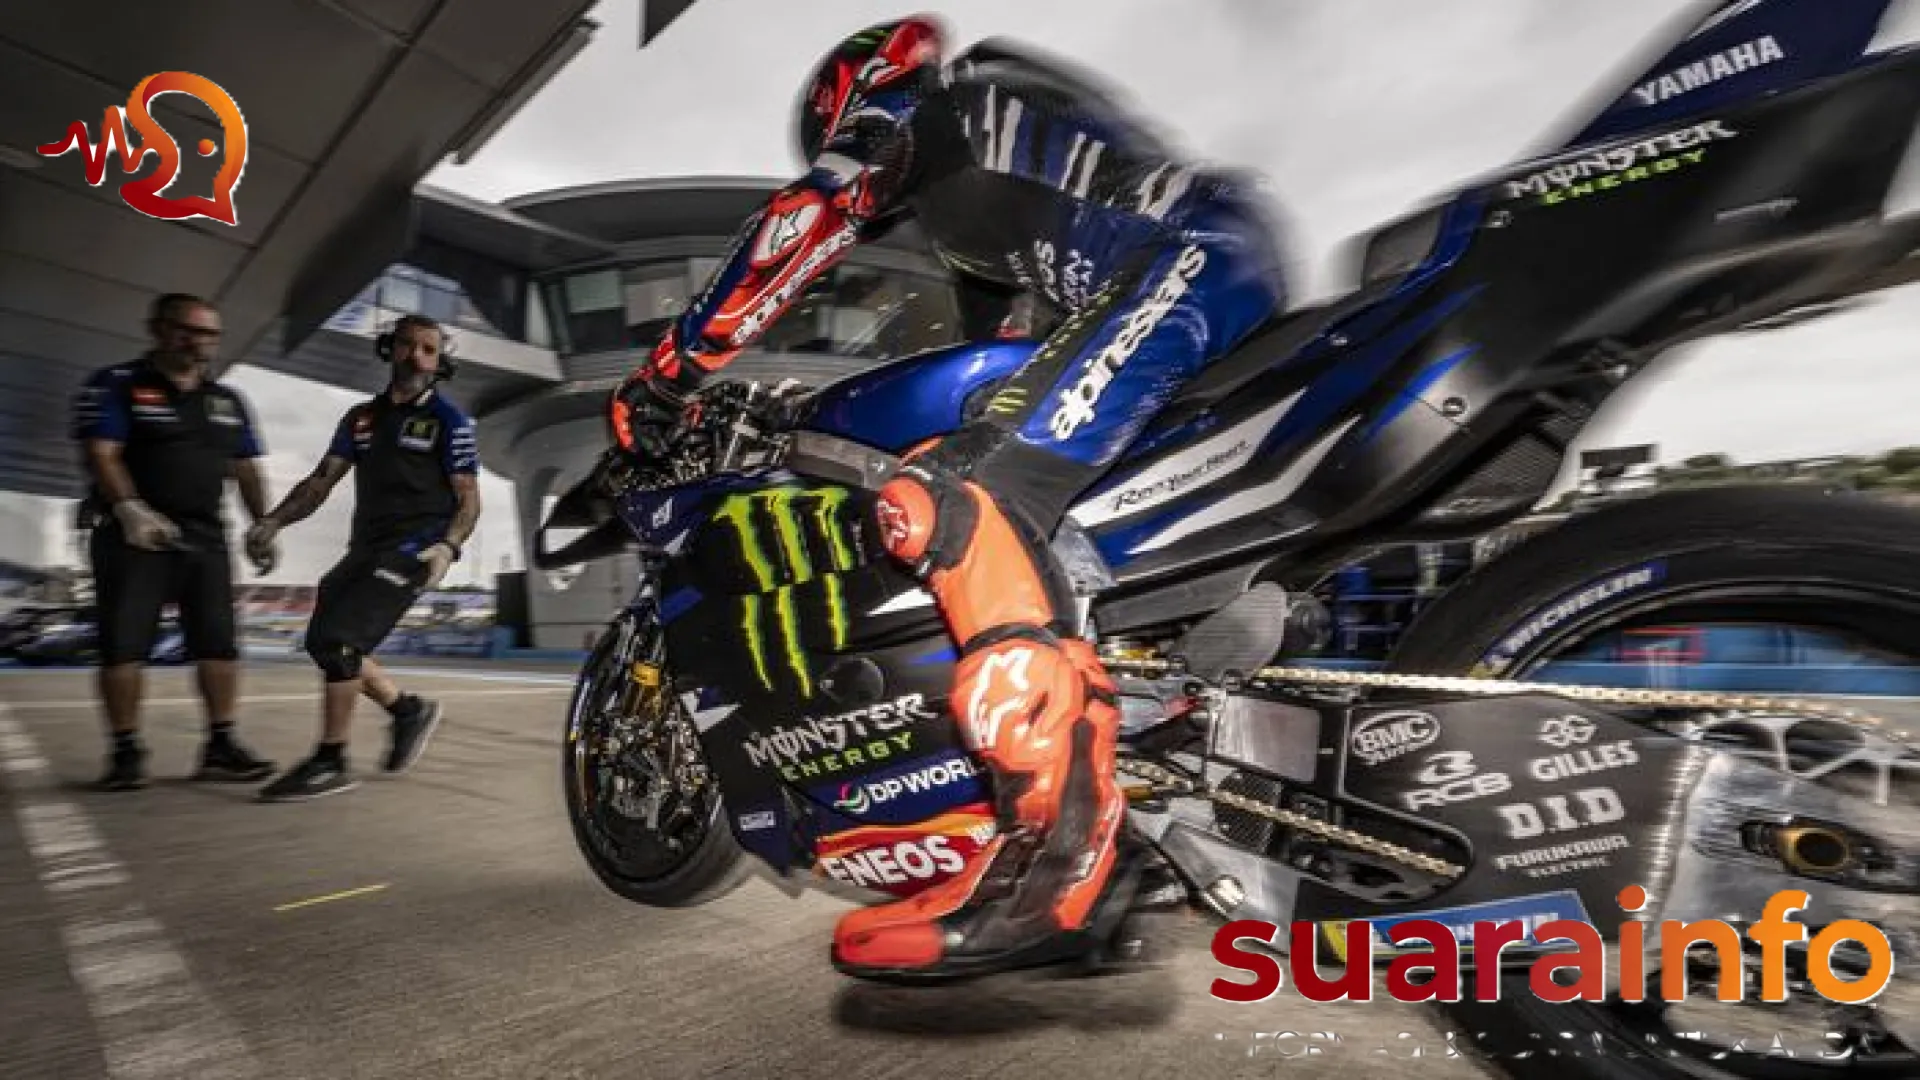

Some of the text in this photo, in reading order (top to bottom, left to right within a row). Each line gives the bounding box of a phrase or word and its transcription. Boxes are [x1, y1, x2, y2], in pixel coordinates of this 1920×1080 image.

[1633, 35, 1784, 105] YAMAHA
[1503, 119, 1738, 199] MONSTER
[1542, 148, 1706, 204] ENERGY
[1502, 568, 1652, 653] MICHELIN
[741, 693, 939, 768] MONSTER
[780, 731, 913, 781] ENERGY
[1362, 716, 1430, 753] BMC
[1530, 739, 1640, 782] GILLES
[820, 834, 965, 888] ENEOS
